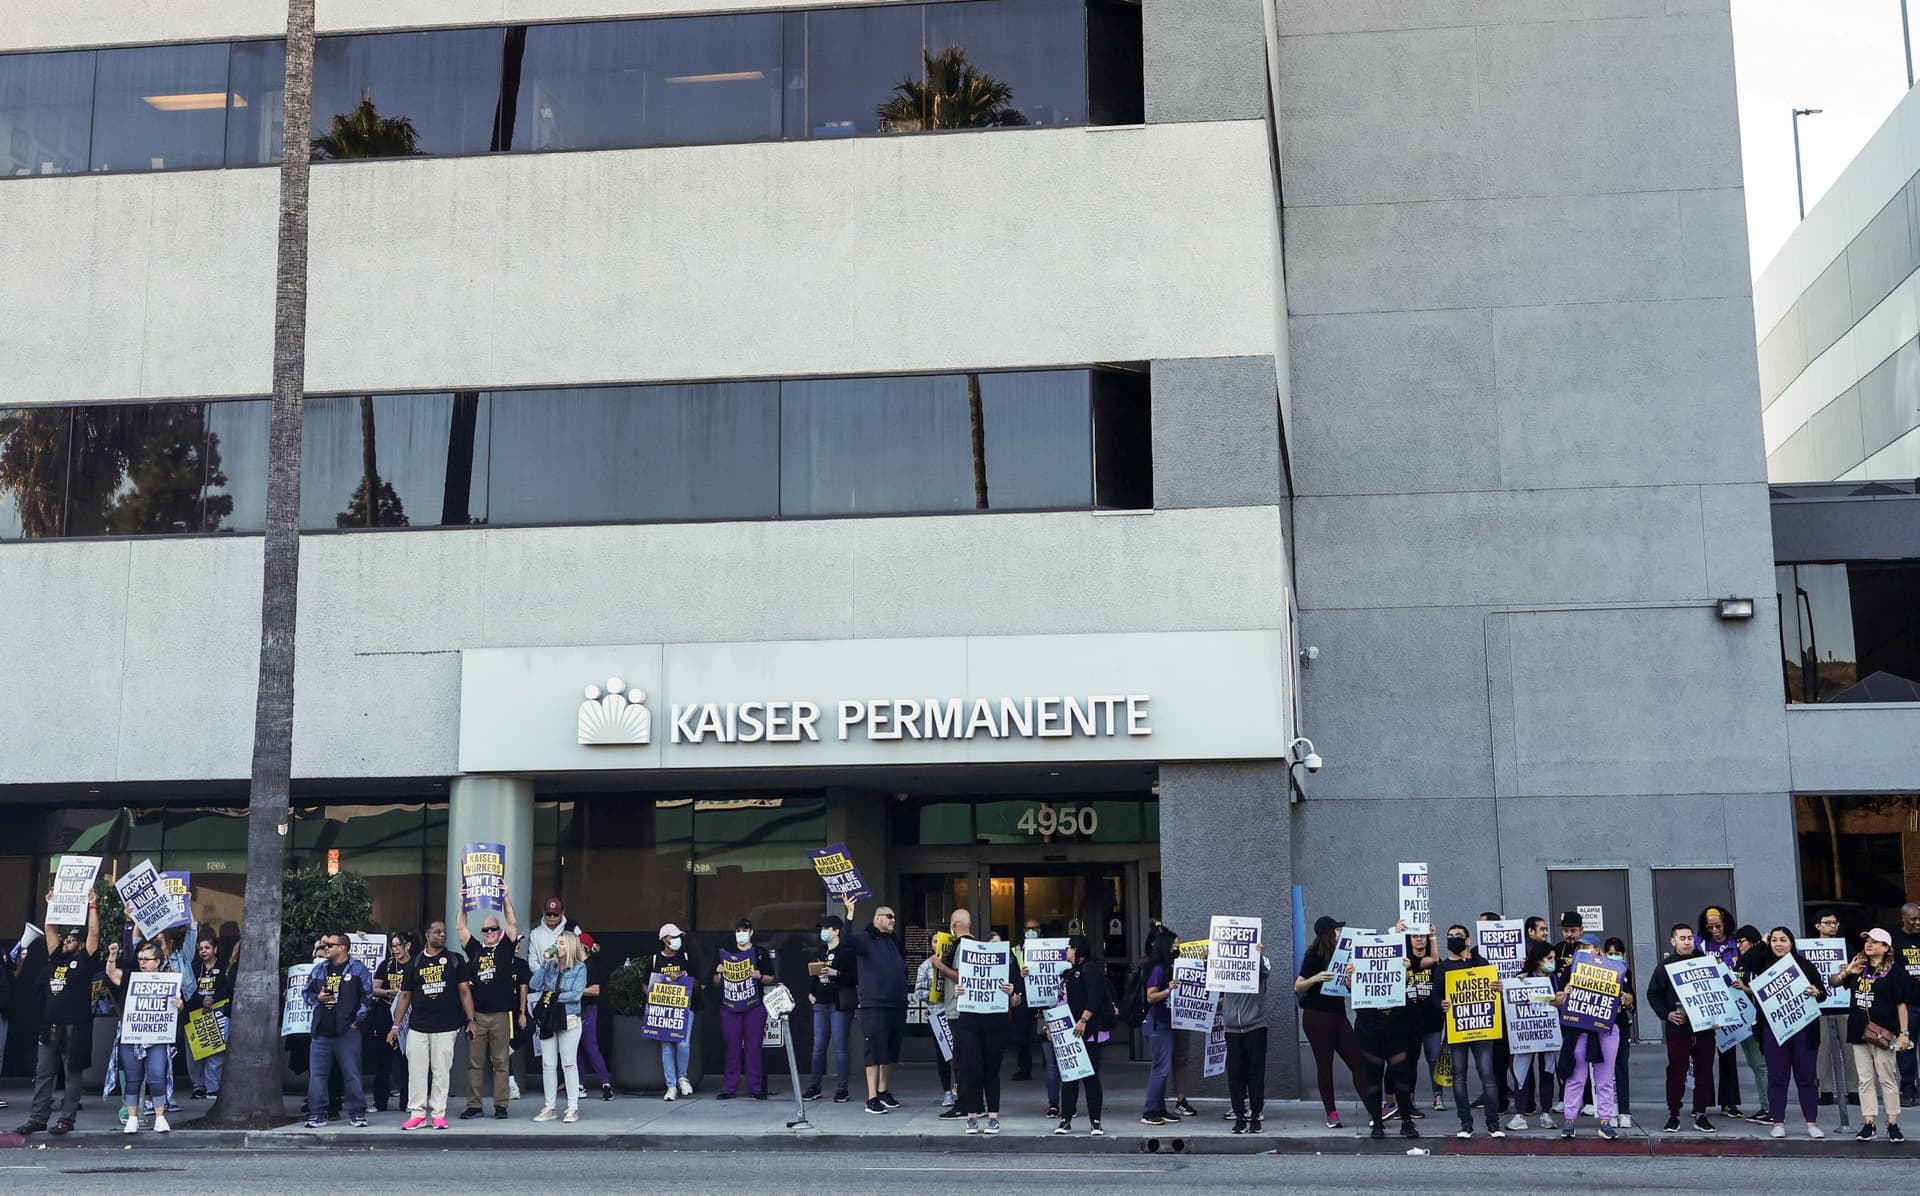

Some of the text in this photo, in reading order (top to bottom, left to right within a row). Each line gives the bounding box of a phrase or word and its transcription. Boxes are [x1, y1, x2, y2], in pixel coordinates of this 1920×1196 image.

[671, 695, 1152, 743] KAISER PERMANENTE
[1017, 807, 1098, 836] 4950
[470, 853, 497, 864] KAISER
[816, 854, 842, 866] KAISER
[63, 865, 94, 878] RESPECT
[465, 863, 501, 874] WORKERS
[817, 861, 851, 874] WORKERS
[465, 875, 491, 887] WON'T
[844, 871, 857, 881] BE
[62, 880, 84, 892] VALUE
[123, 871, 155, 900] RESPECT
[466, 886, 500, 898] SILENCED
[134, 886, 158, 909] VALUE
[53, 905, 81, 914] WORKERS
[135, 894, 170, 923] HEALTHCARE
[1404, 899, 1429, 911] PATIE
[144, 906, 171, 927] WORKERS
[1214, 927, 1256, 942] RESPECT
[1482, 931, 1519, 943] RESPECT
[1032, 950, 1063, 961] KAISER:
[1181, 944, 1208, 954] KAISE
[1219, 944, 1249, 958] VALUE
[1362, 946, 1397, 958] KAISER:
[1488, 947, 1515, 959] VALUE
[1804, 950, 1838, 961] KAISER:
[967, 952, 1000, 965] KAISER:
[1210, 959, 1257, 971] HEALTHCARE
[725, 960, 749, 971] KAISER
[973, 965, 992, 978] PUT
[1039, 962, 1056, 974] PUT
[1369, 960, 1389, 972] PUT
[1490, 960, 1522, 971] THCAR
[1815, 961, 1832, 973] PUT
[1178, 967, 1207, 982] RESPE
[1214, 970, 1251, 982] WORKERS
[1355, 971, 1402, 984] PATIENTS
[1580, 964, 1614, 982] KAISER
[1679, 968, 1714, 983] KAISER:
[724, 978, 755, 992] WON'T BE
[961, 976, 1005, 990] PATIENTS
[1028, 974, 1061, 986] PATIEN
[1456, 978, 1490, 992] KAISER
[1573, 974, 1617, 994] WORKERS
[1692, 980, 1712, 993] PUT
[1764, 972, 1795, 997] KAISER:
[133, 982, 175, 995] RESPECT
[293, 988, 303, 998] PU
[656, 985, 682, 996] KAISER
[724, 987, 756, 1002] SILENCED
[1037, 987, 1055, 997] FIR
[1181, 984, 1209, 1000] VALUE
[1364, 984, 1393, 997] FIRST
[1775, 984, 1795, 1005] PUT
[651, 994, 687, 1006] WORKERS
[968, 990, 996, 1002] FIRST
[1449, 989, 1497, 1004] WORKERS
[1569, 988, 1615, 1009] WON'T BE
[1685, 990, 1730, 1008] PATIENTS
[137, 998, 167, 1011] VALUE
[1456, 1003, 1491, 1018] ON ULP
[1567, 999, 1612, 1020] SILENCED
[1699, 1003, 1727, 1018] FIRST
[1770, 988, 1810, 1023] PATIENTS
[126, 1012, 175, 1023] HEALTHCARE
[288, 1010, 313, 1023] FIRST
[649, 1006, 685, 1019] WON'T BE
[1175, 1008, 1208, 1021] WORKERS
[1783, 1006, 1807, 1029] FIRST
[131, 1022, 168, 1033] WORKERS
[647, 1016, 684, 1030] SILENCED
[770, 1020, 779, 1029] Kit
[1457, 1015, 1492, 1030] STRIKE
[1510, 1018, 1557, 1031] HEALTHCARE
[194, 1017, 209, 1049] KAISER
[767, 1031, 779, 1040] Box
[1052, 1032, 1066, 1045] PUT
[1516, 1029, 1554, 1042] WORKERS
[1059, 1056, 1080, 1070] FIRST
